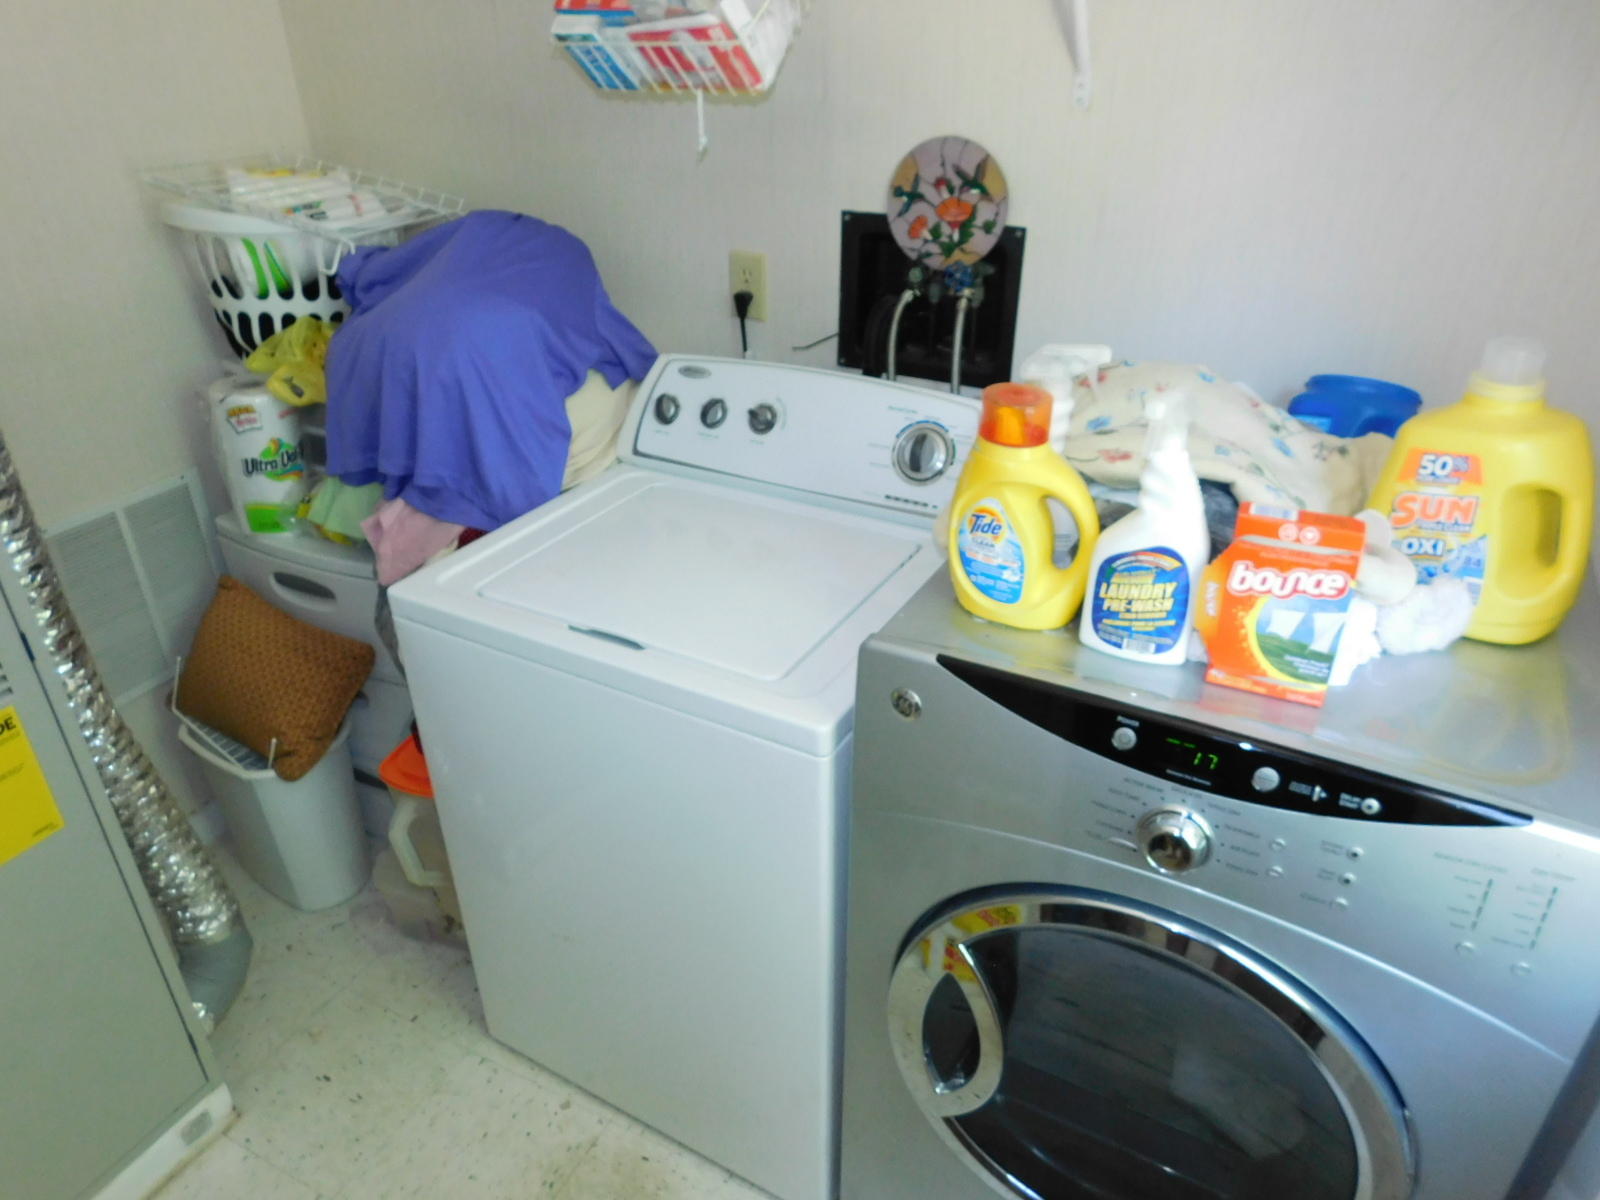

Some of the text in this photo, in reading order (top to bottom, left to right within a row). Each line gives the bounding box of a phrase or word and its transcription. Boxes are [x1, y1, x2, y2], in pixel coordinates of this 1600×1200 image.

[1391, 492, 1478, 528] SUN
[970, 513, 1002, 535] Tide
[1401, 537, 1444, 556] OXI
[1229, 561, 1348, 598] bounce
[1099, 582, 1178, 600] LAUNDRY
[1193, 752, 1218, 769] 17
